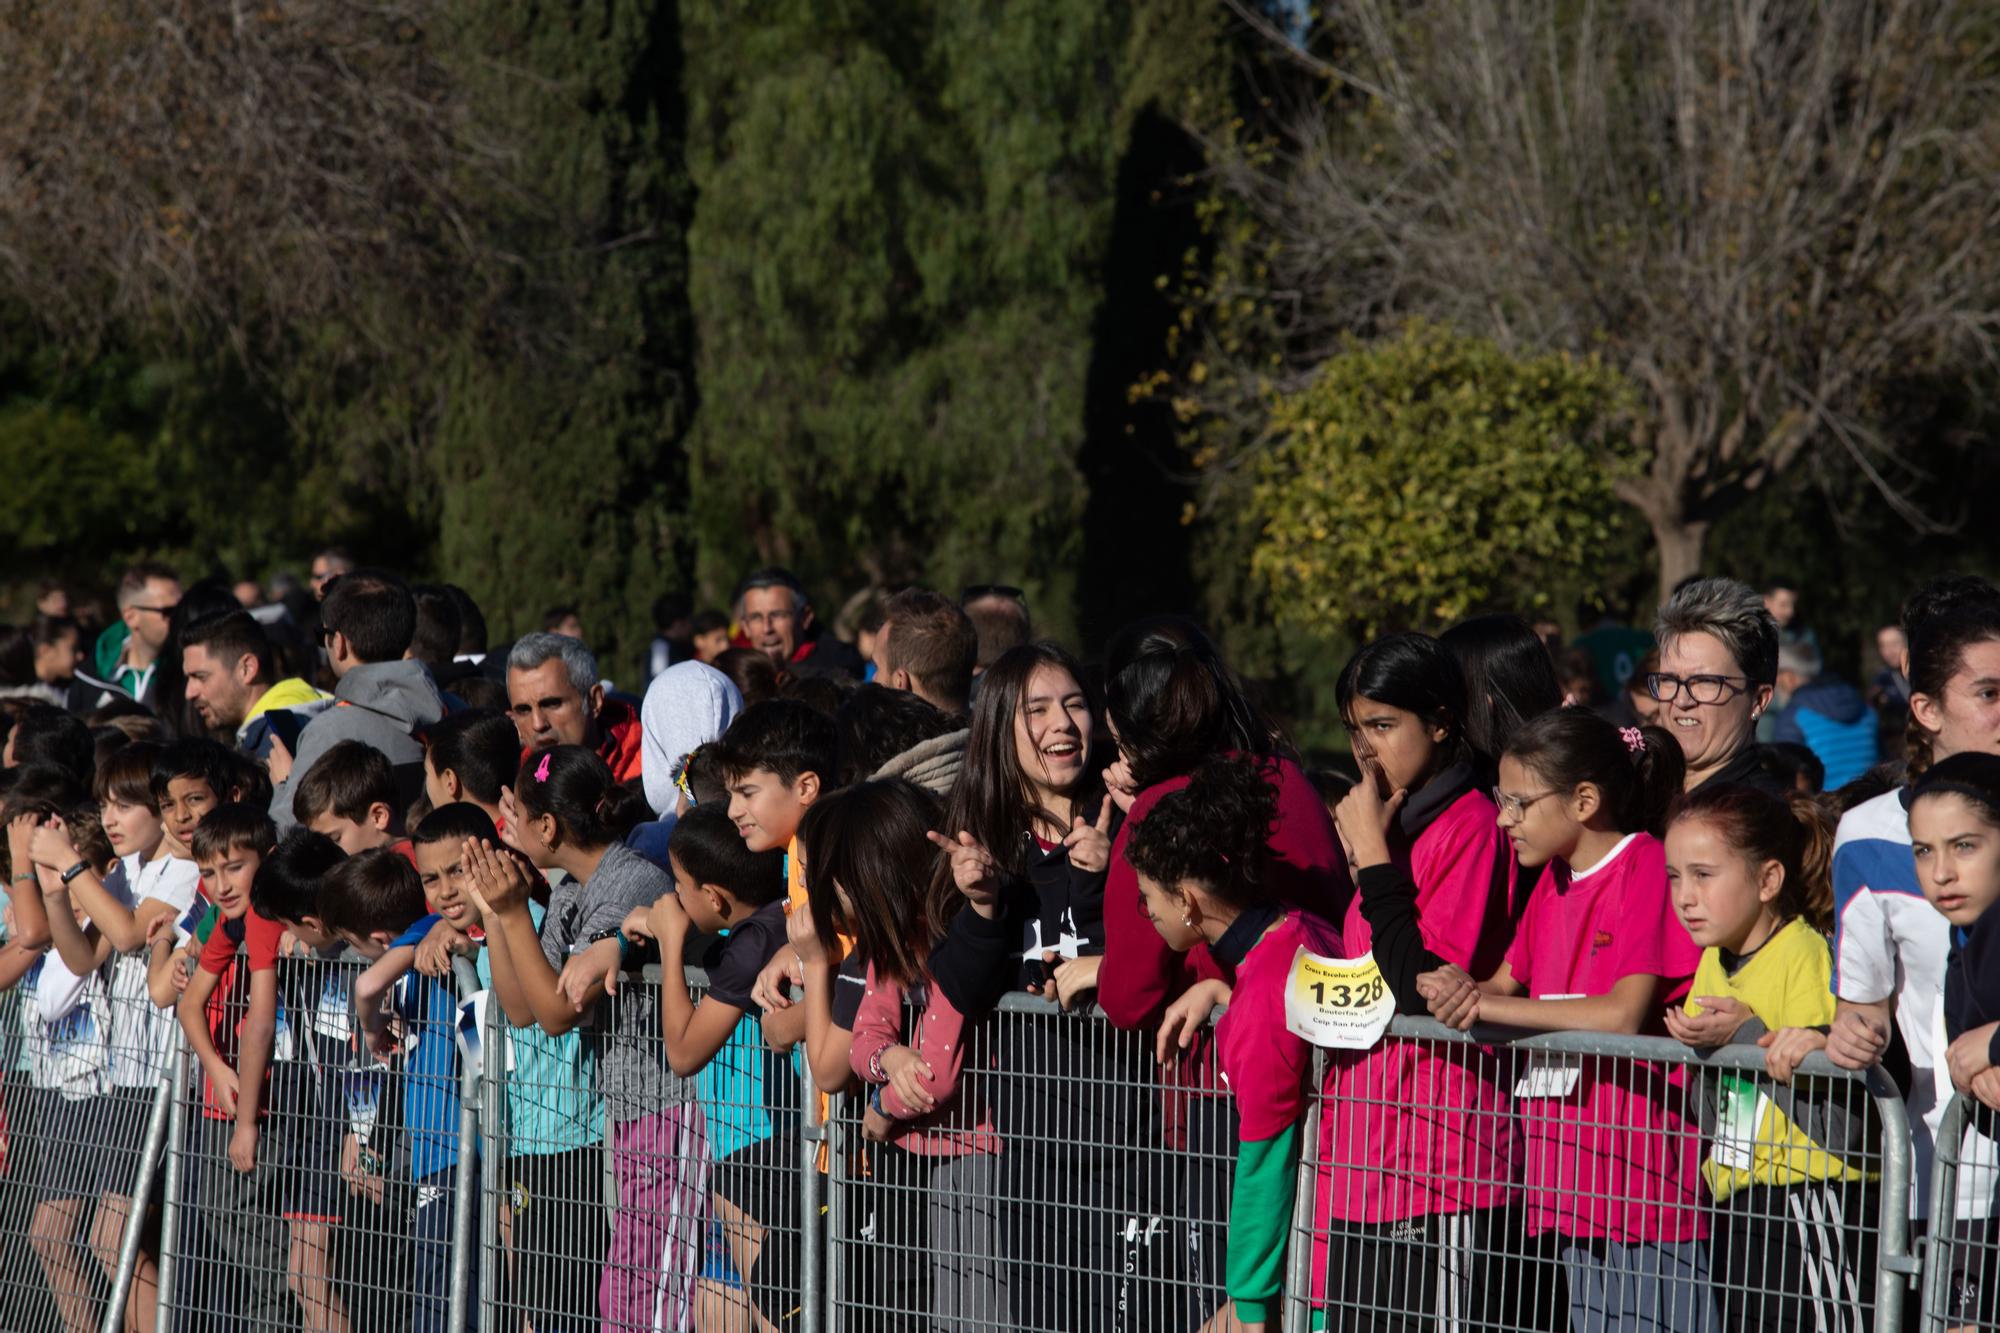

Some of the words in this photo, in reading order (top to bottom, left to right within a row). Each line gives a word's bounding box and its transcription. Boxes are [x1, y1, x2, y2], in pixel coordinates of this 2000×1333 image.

[1304, 964, 1321, 975] Cross
[1322, 970, 1349, 978] Escolar
[1310, 975, 1384, 1008] 1328
